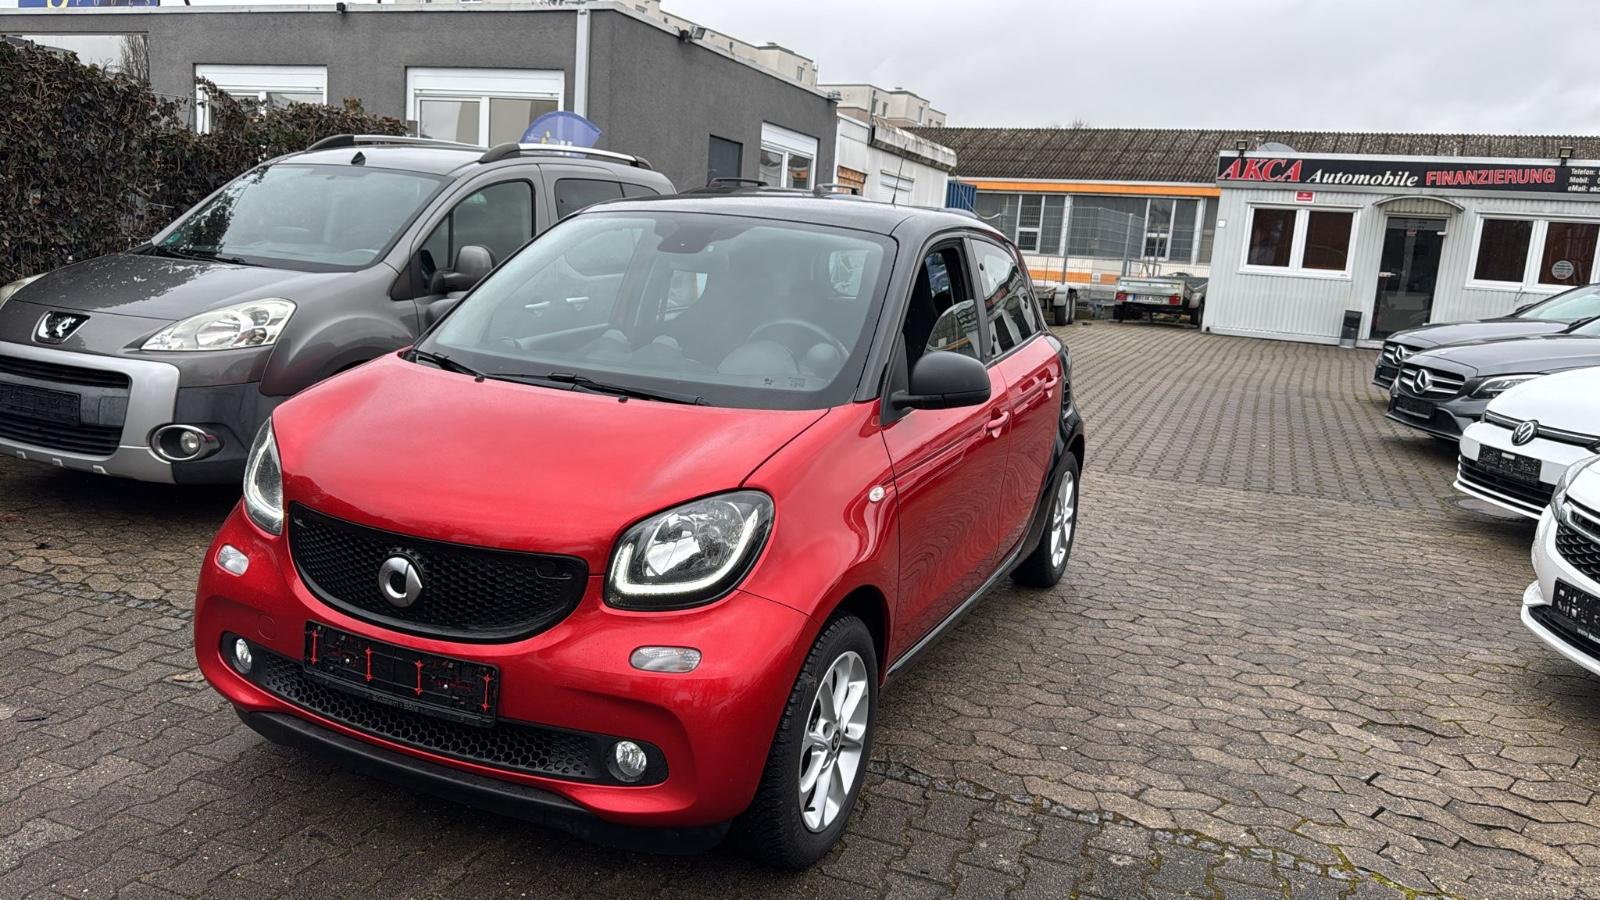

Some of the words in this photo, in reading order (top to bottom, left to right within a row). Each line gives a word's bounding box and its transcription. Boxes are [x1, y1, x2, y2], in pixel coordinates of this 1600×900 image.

[1218, 158, 1303, 182] AKCA
[1306, 168, 1419, 187] Automobile
[1425, 168, 1556, 186] FINANZIERUNG
[1571, 168, 1596, 176] Telefon:
